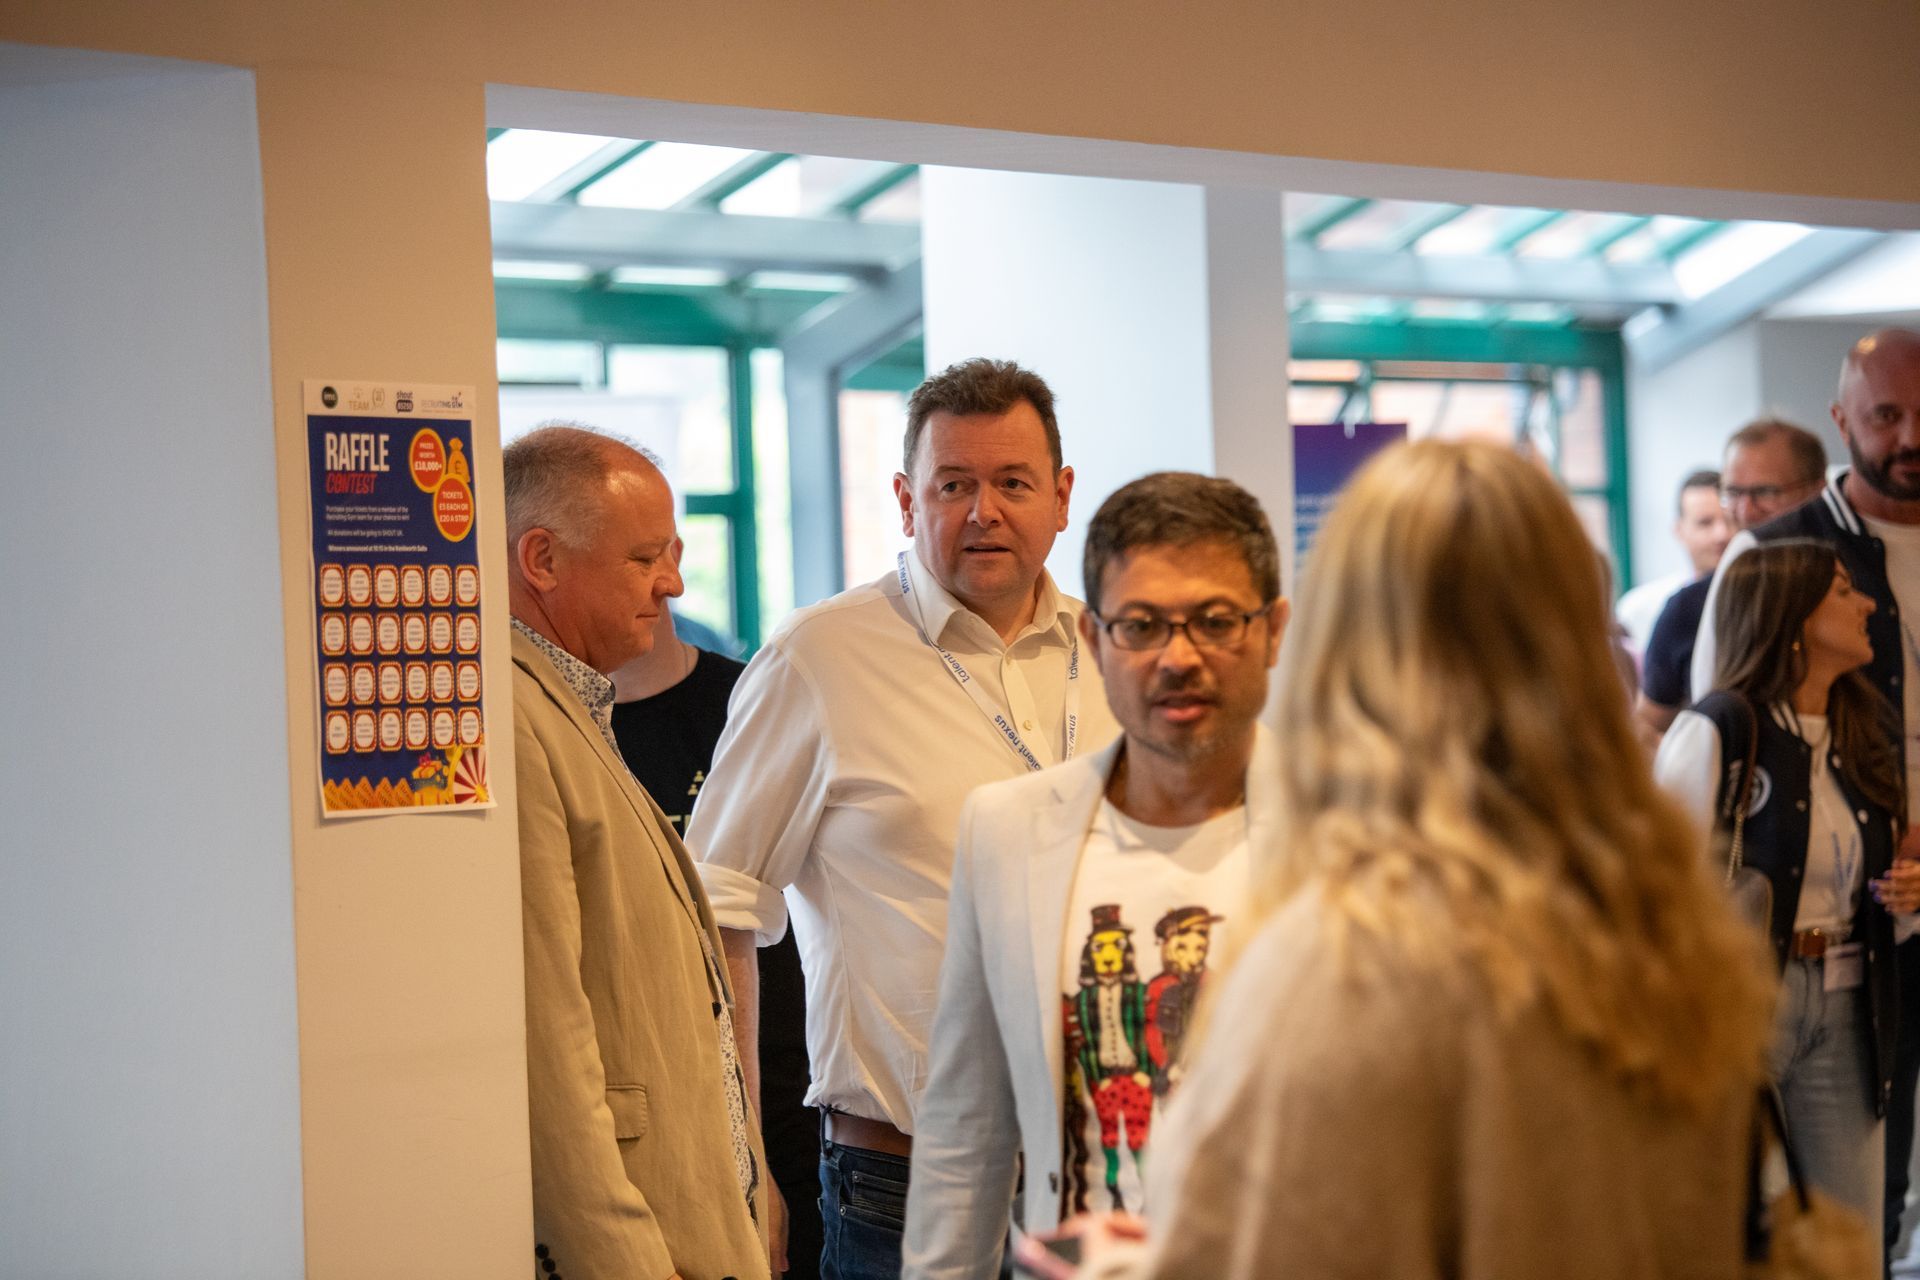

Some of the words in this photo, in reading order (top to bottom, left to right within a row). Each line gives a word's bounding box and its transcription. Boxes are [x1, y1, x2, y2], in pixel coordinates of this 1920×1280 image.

[325, 433, 390, 472] RAFFLE
[326, 472, 378, 494] CONTEST
[442, 491, 464, 499] TICKETS
[944, 652, 970, 683] talent
[994, 714, 1020, 746] nexus
[1018, 744, 1044, 772] alent
